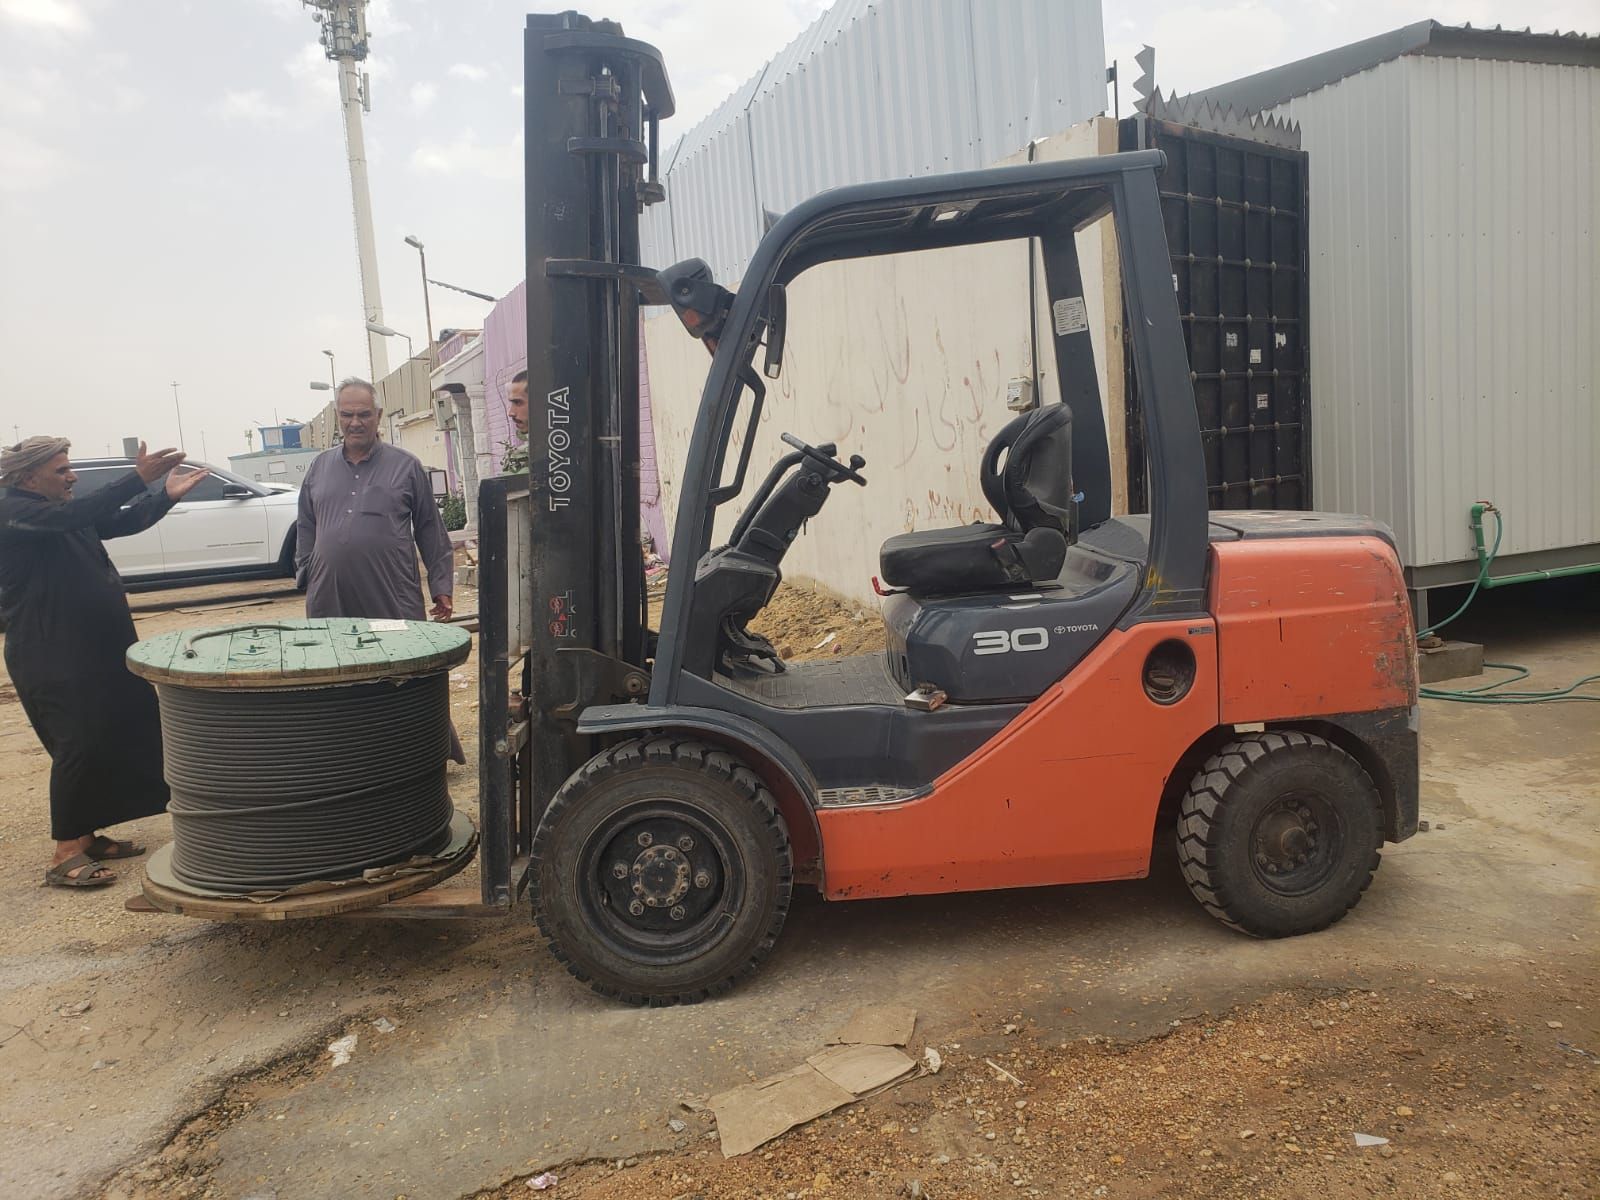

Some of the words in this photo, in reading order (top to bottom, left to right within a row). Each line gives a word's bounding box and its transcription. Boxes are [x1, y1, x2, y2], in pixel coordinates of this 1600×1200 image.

[548, 386, 571, 512] TOYOTA
[972, 627, 1049, 655] 30
[1067, 624, 1099, 633] TOYOTA
